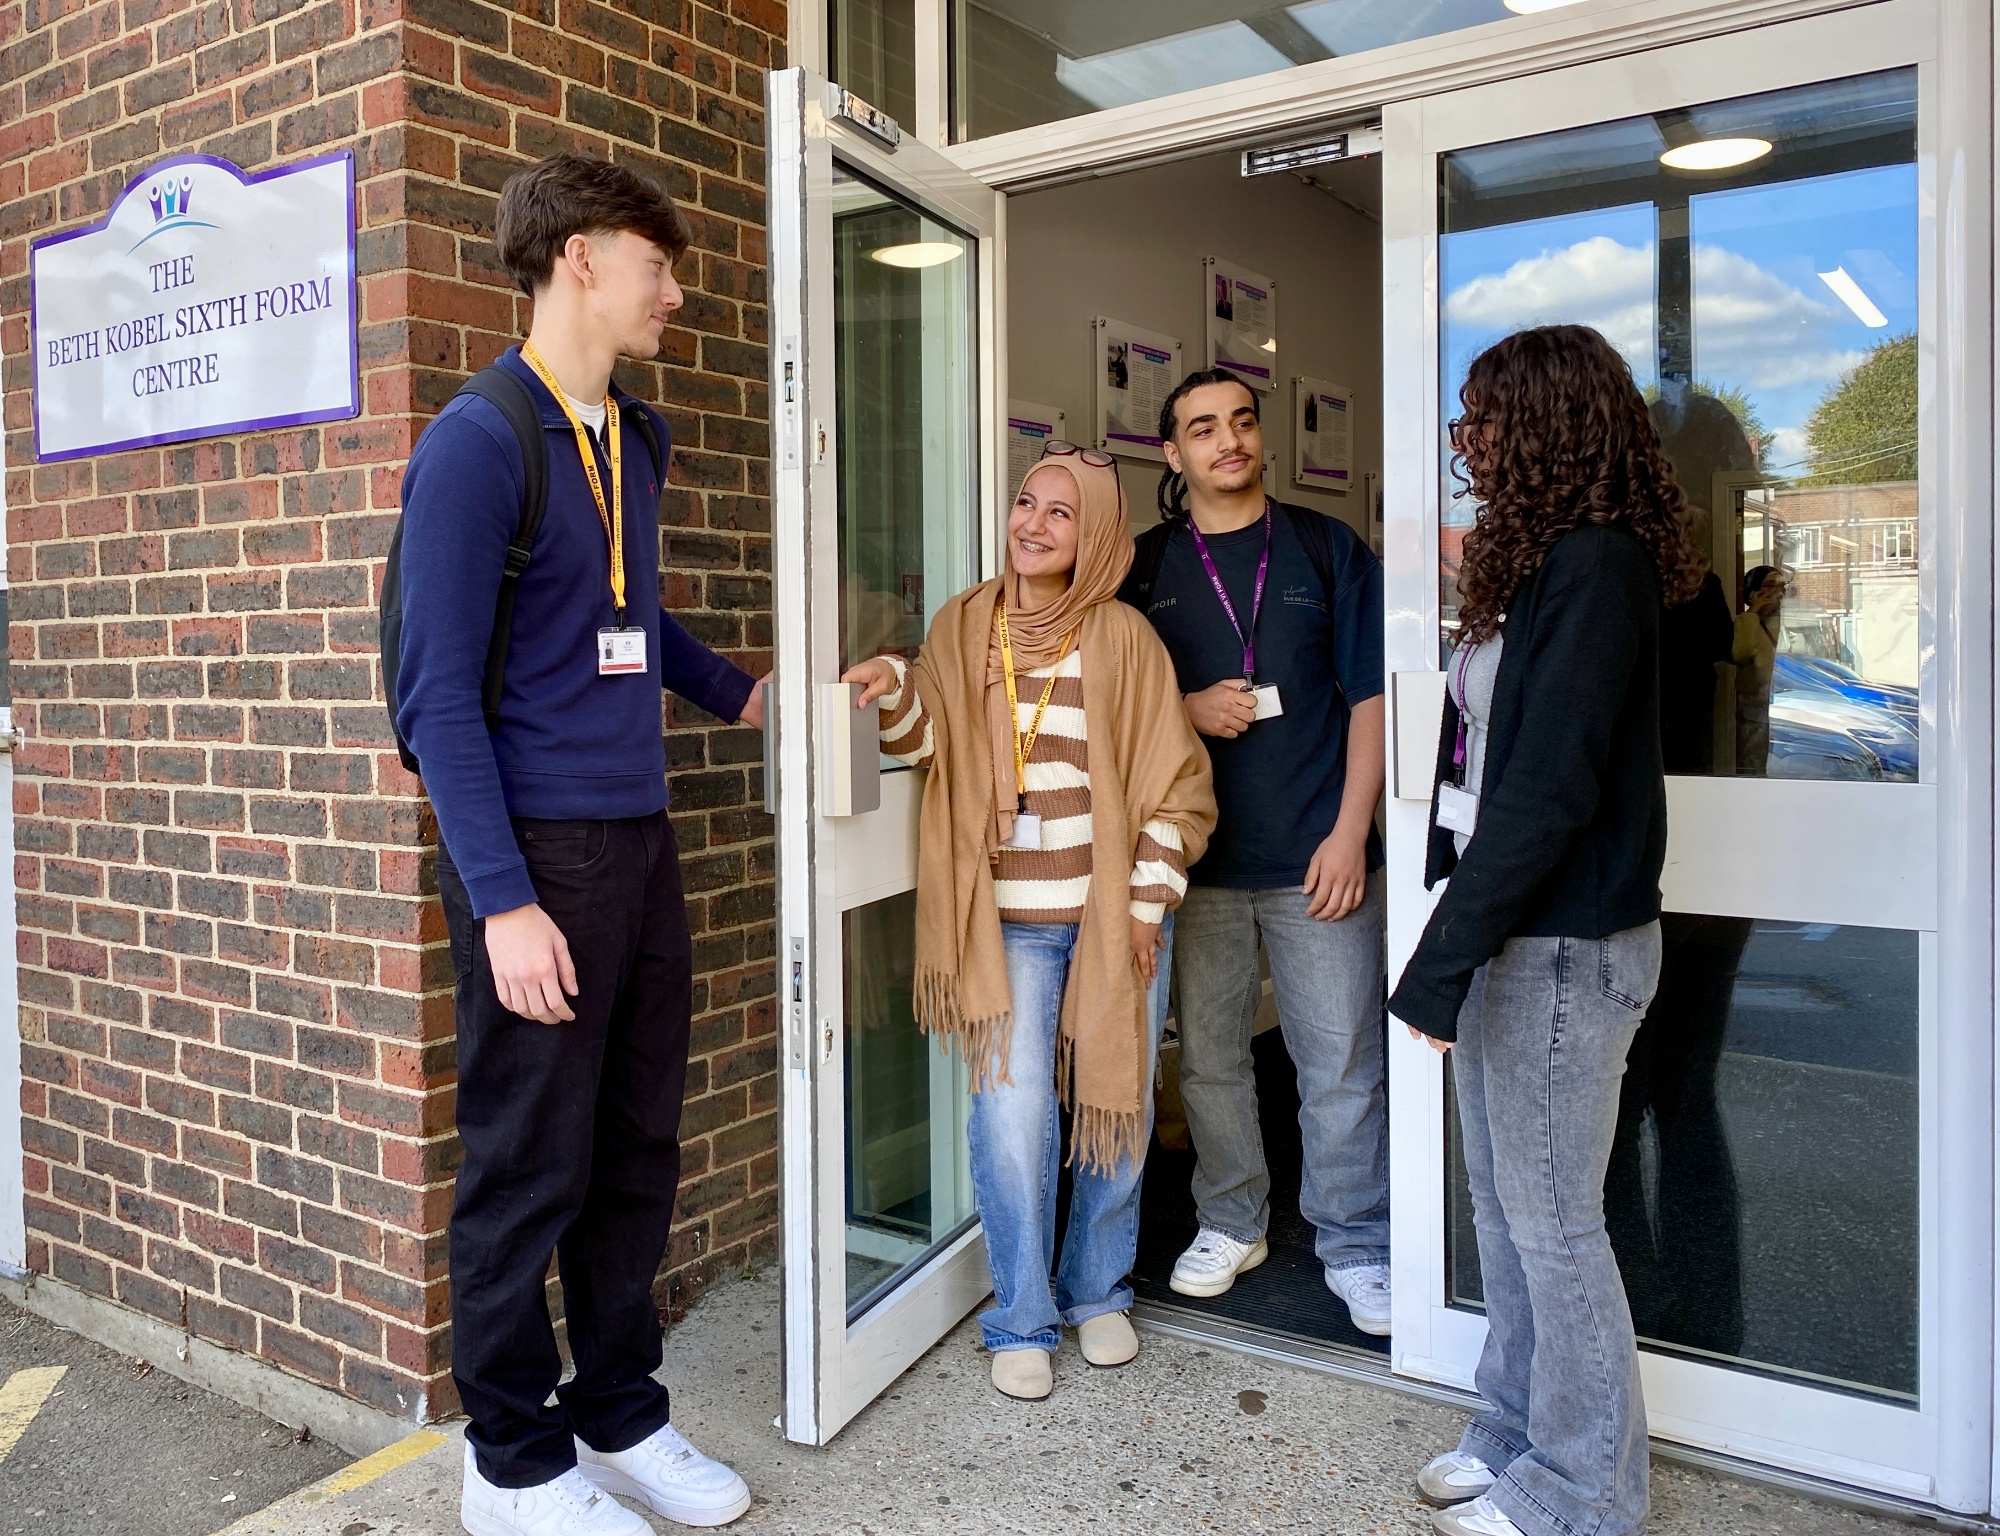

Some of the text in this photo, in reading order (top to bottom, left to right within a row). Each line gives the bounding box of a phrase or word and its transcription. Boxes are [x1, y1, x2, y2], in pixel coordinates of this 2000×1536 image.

[149, 255, 195, 293] THE
[48, 277, 332, 367] BETH KOBEL SIXTH FORM
[132, 353, 219, 397] CENTRE
[609, 404, 617, 427] FORM
[588, 465, 599, 490] FORM
[596, 491, 602, 500] VI
[1212, 576, 1223, 593] FORM
[1001, 629, 1009, 649] FORM
[1030, 710, 1042, 735] MANOR
